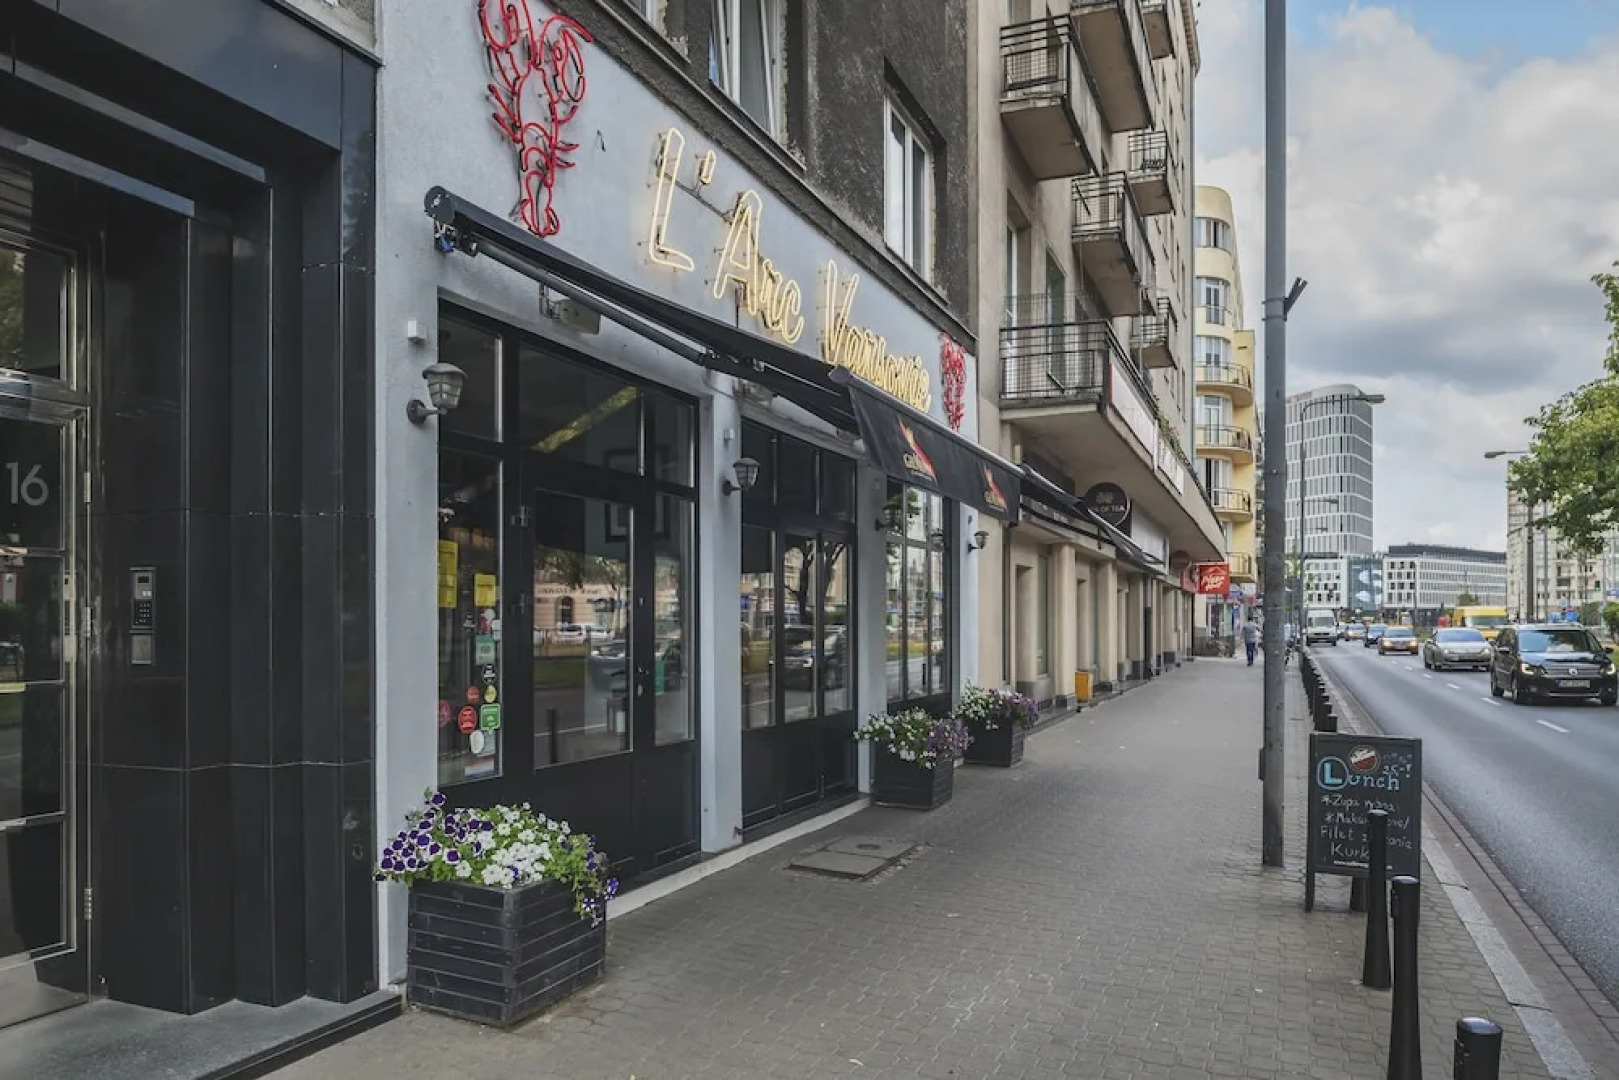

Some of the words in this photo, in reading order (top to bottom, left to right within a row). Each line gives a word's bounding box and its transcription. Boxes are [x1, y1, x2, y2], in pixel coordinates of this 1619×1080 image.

[649, 127, 804, 343] L'Arc
[6, 462, 49, 506] 16
[1321, 760, 1400, 791] Lunch
